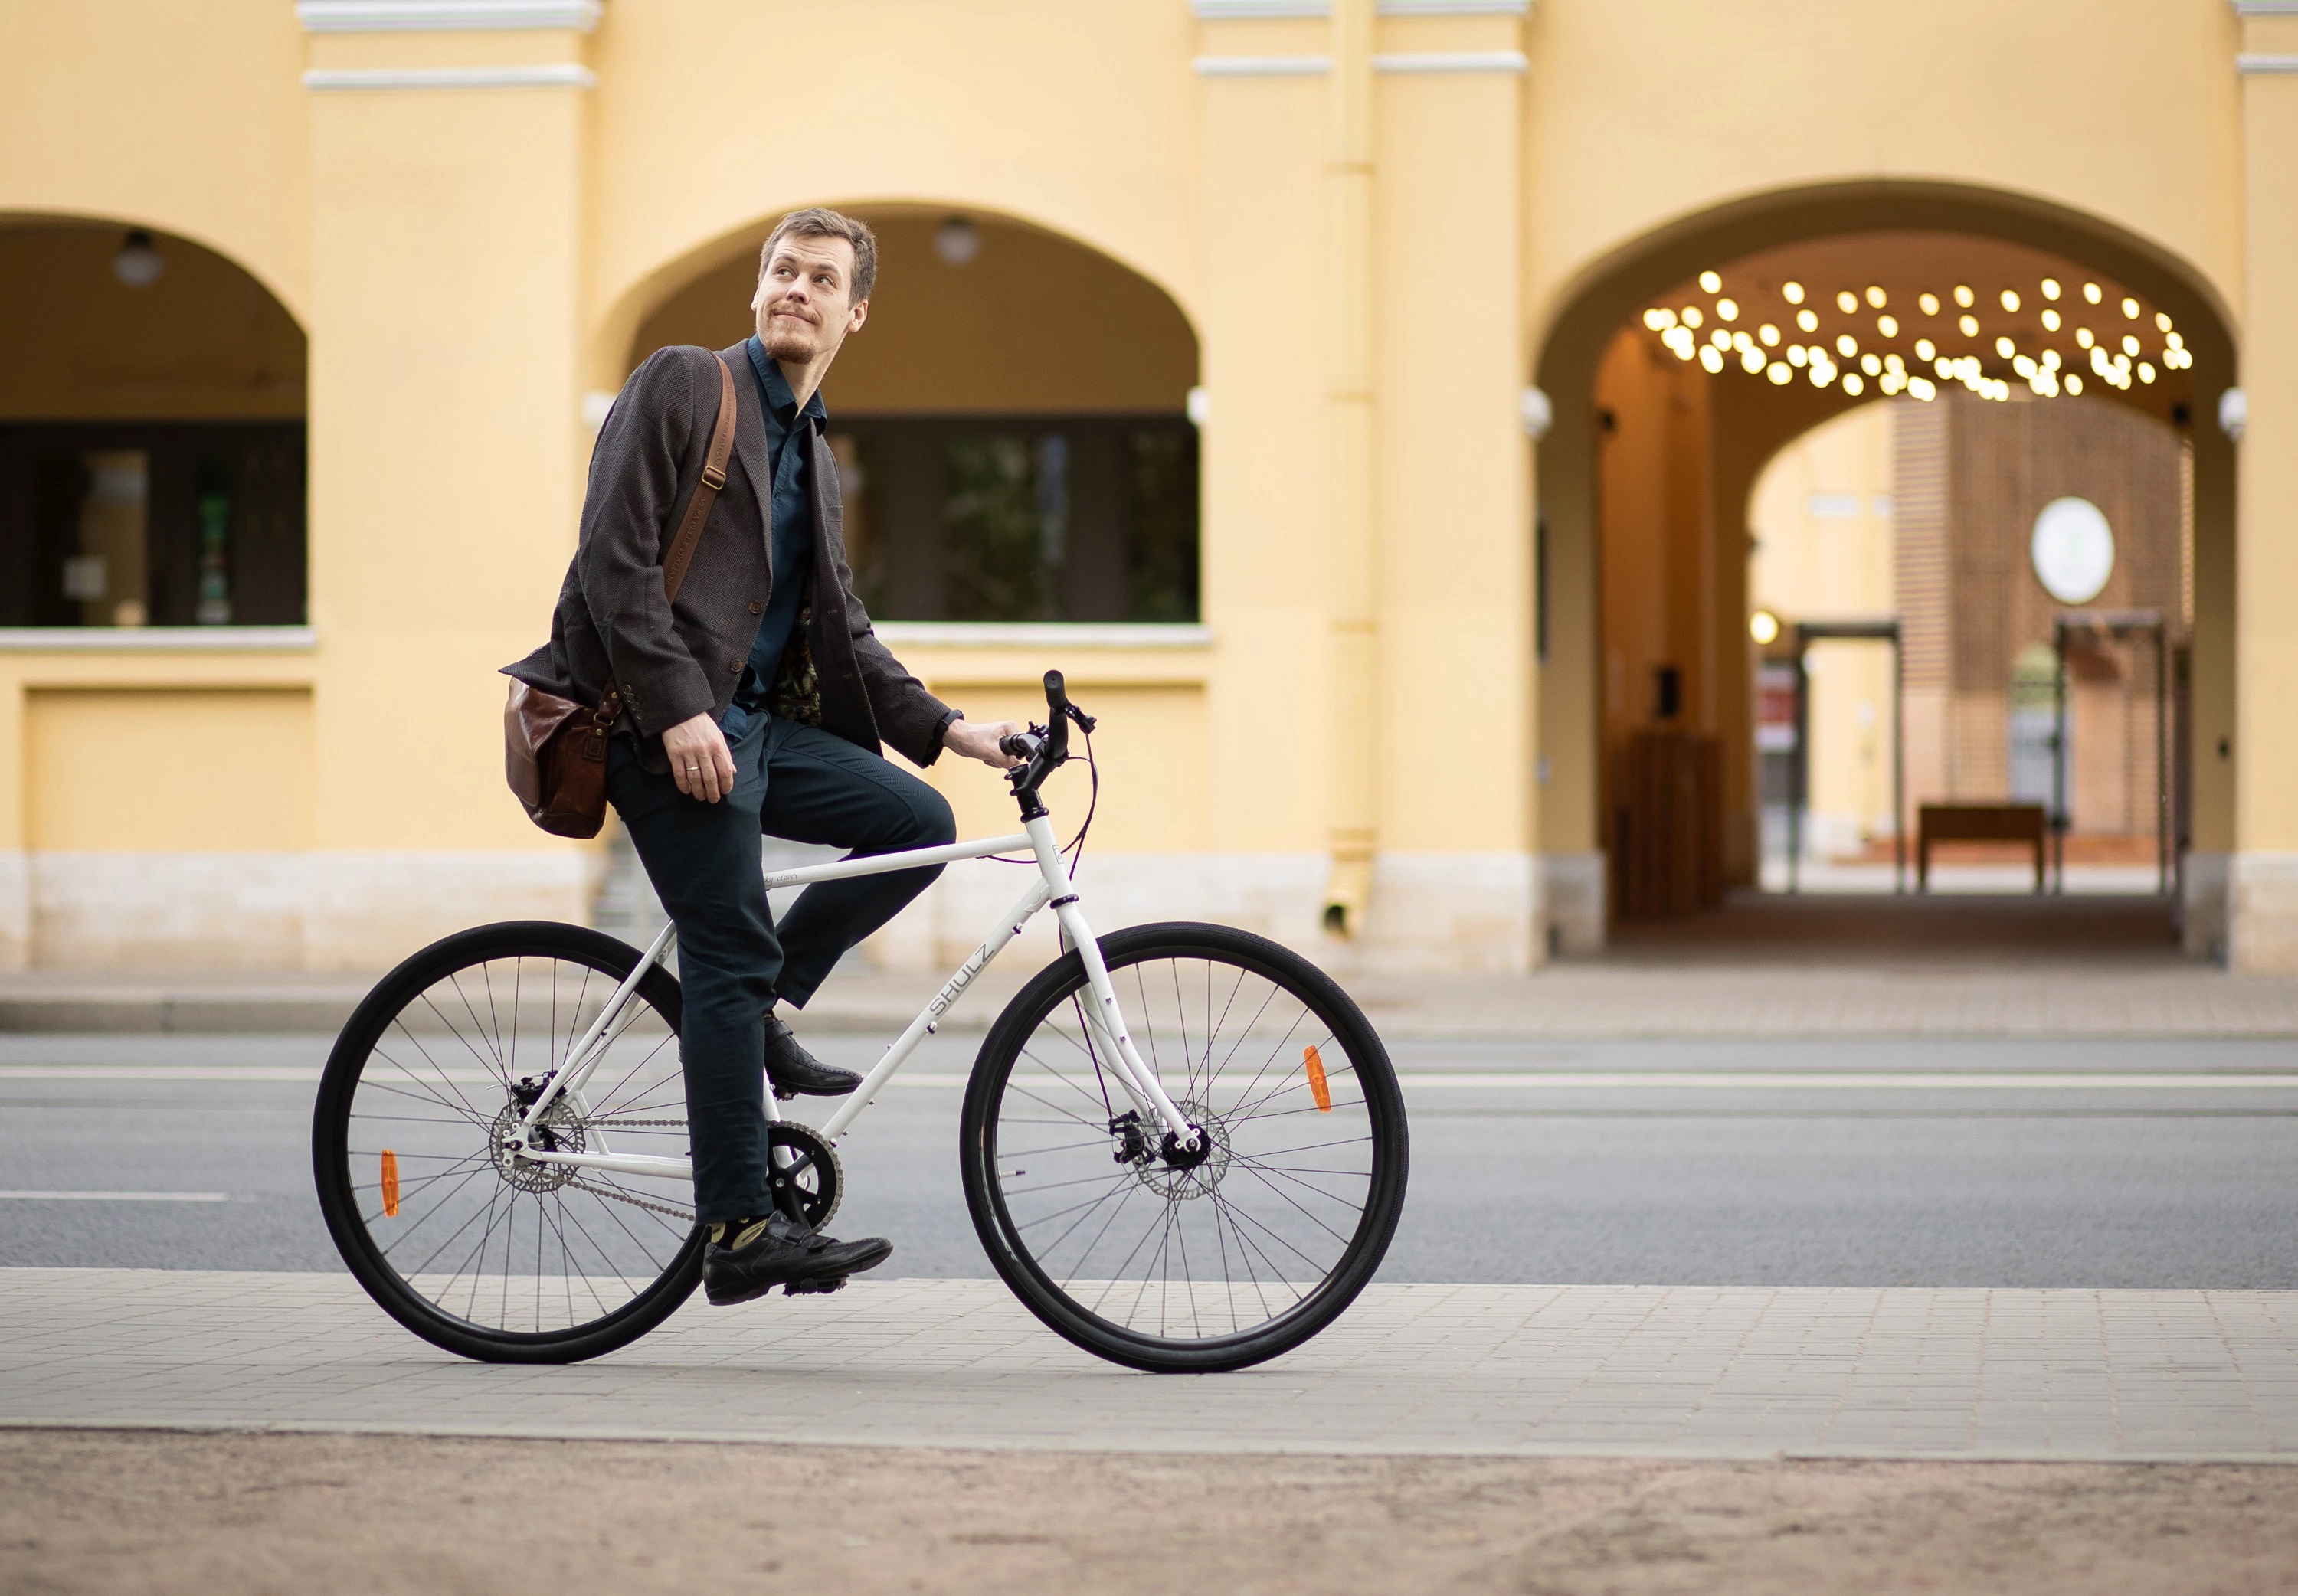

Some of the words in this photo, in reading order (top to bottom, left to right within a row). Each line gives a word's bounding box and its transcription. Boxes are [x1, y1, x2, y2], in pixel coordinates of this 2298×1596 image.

[692, 499, 706, 520] VERA
[682, 521, 698, 548] PELLE
[666, 548, 686, 586] ITALIANA
[777, 873, 797, 881] clover
[928, 943, 994, 1016] SHULZ
